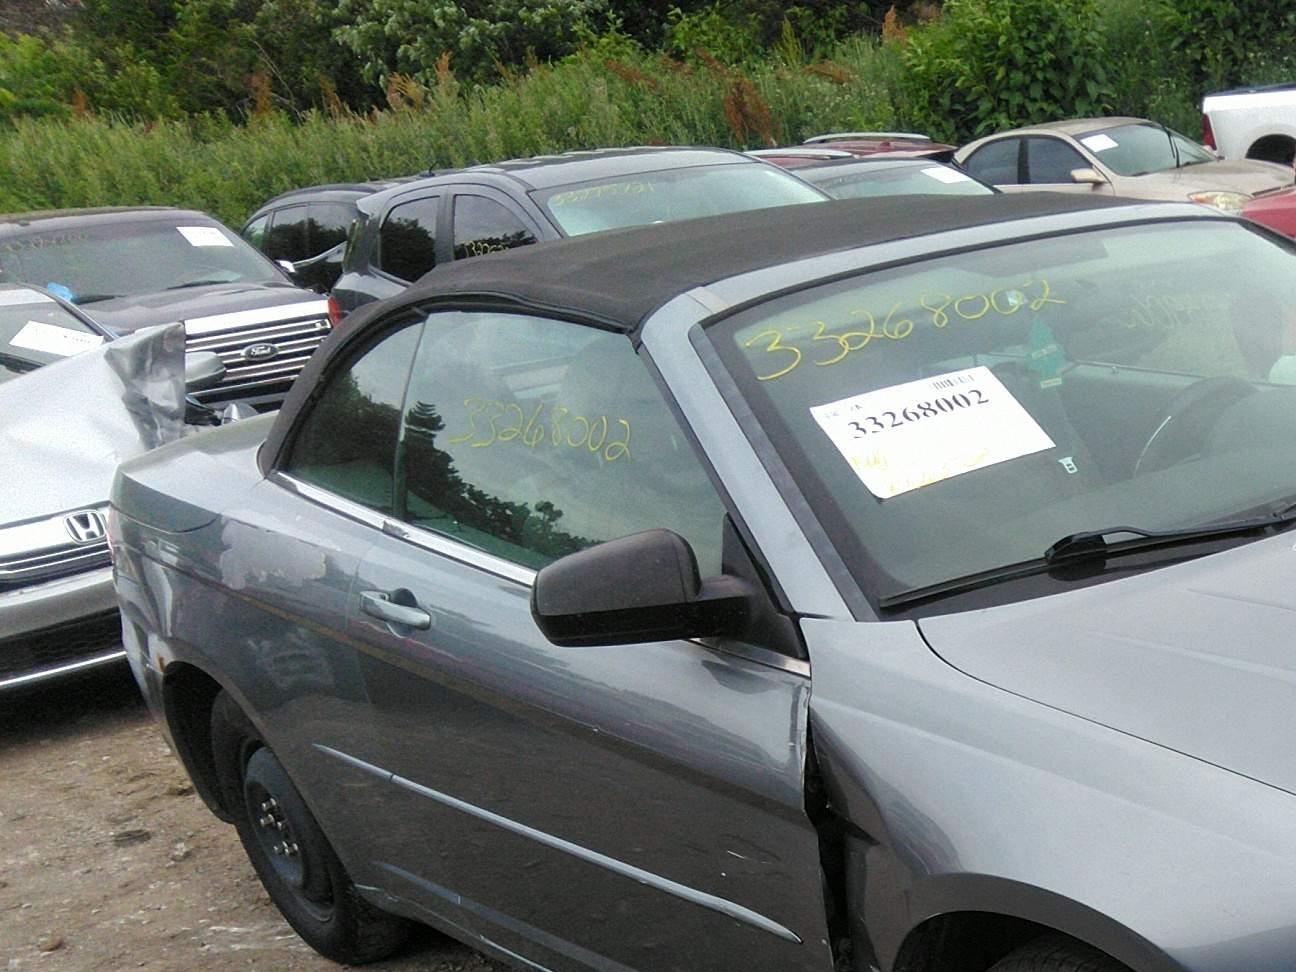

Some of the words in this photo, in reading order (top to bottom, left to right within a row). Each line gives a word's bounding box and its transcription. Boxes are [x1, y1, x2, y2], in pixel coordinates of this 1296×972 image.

[745, 279, 1067, 381] 33268002
[448, 398, 632, 463] 33268002
[847, 388, 990, 439] 33268002
